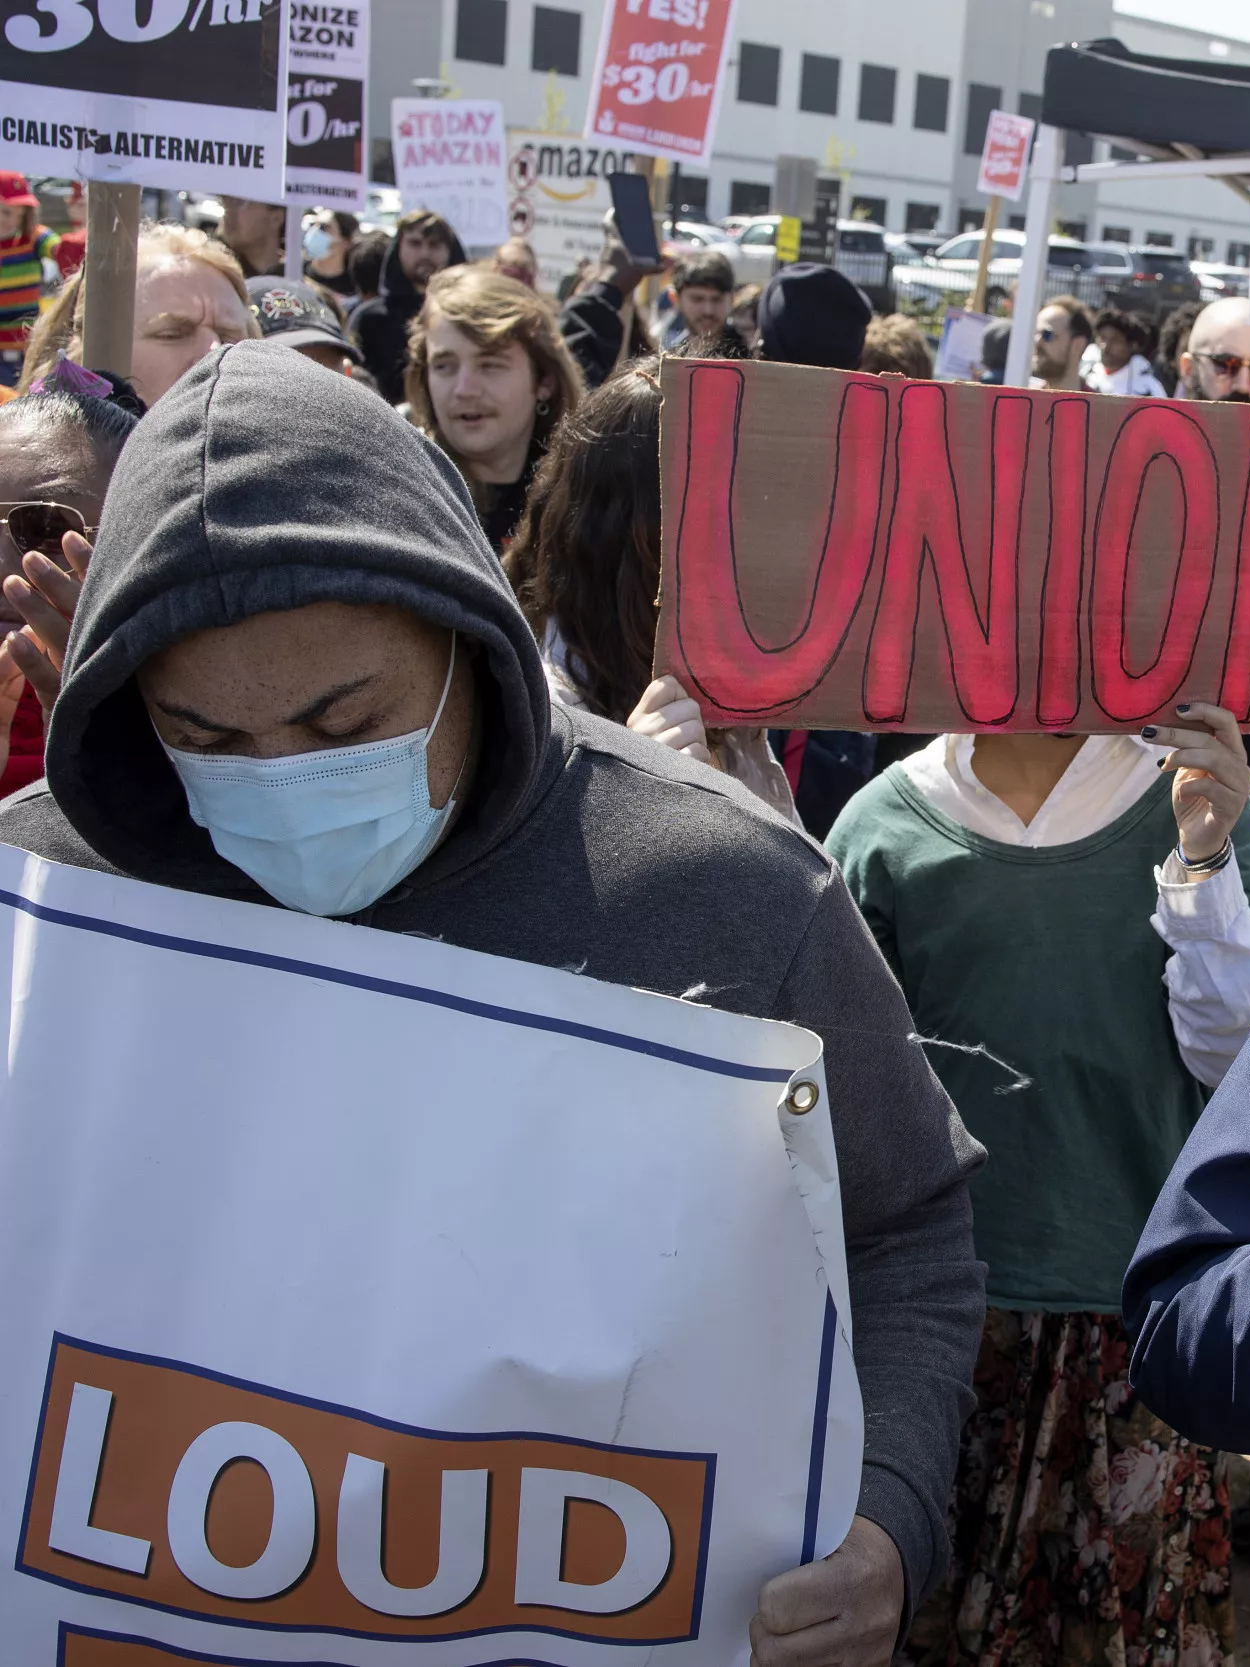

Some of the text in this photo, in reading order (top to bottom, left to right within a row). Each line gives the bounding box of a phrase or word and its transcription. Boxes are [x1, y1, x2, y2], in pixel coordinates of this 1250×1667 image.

[407, 111, 495, 138] TODAY
[0, 117, 265, 169] CIALIST ALTERNATIVE
[403, 141, 501, 168] AMAZON
[523, 143, 638, 178] mazo
[48, 1381, 673, 1618] LOUD
